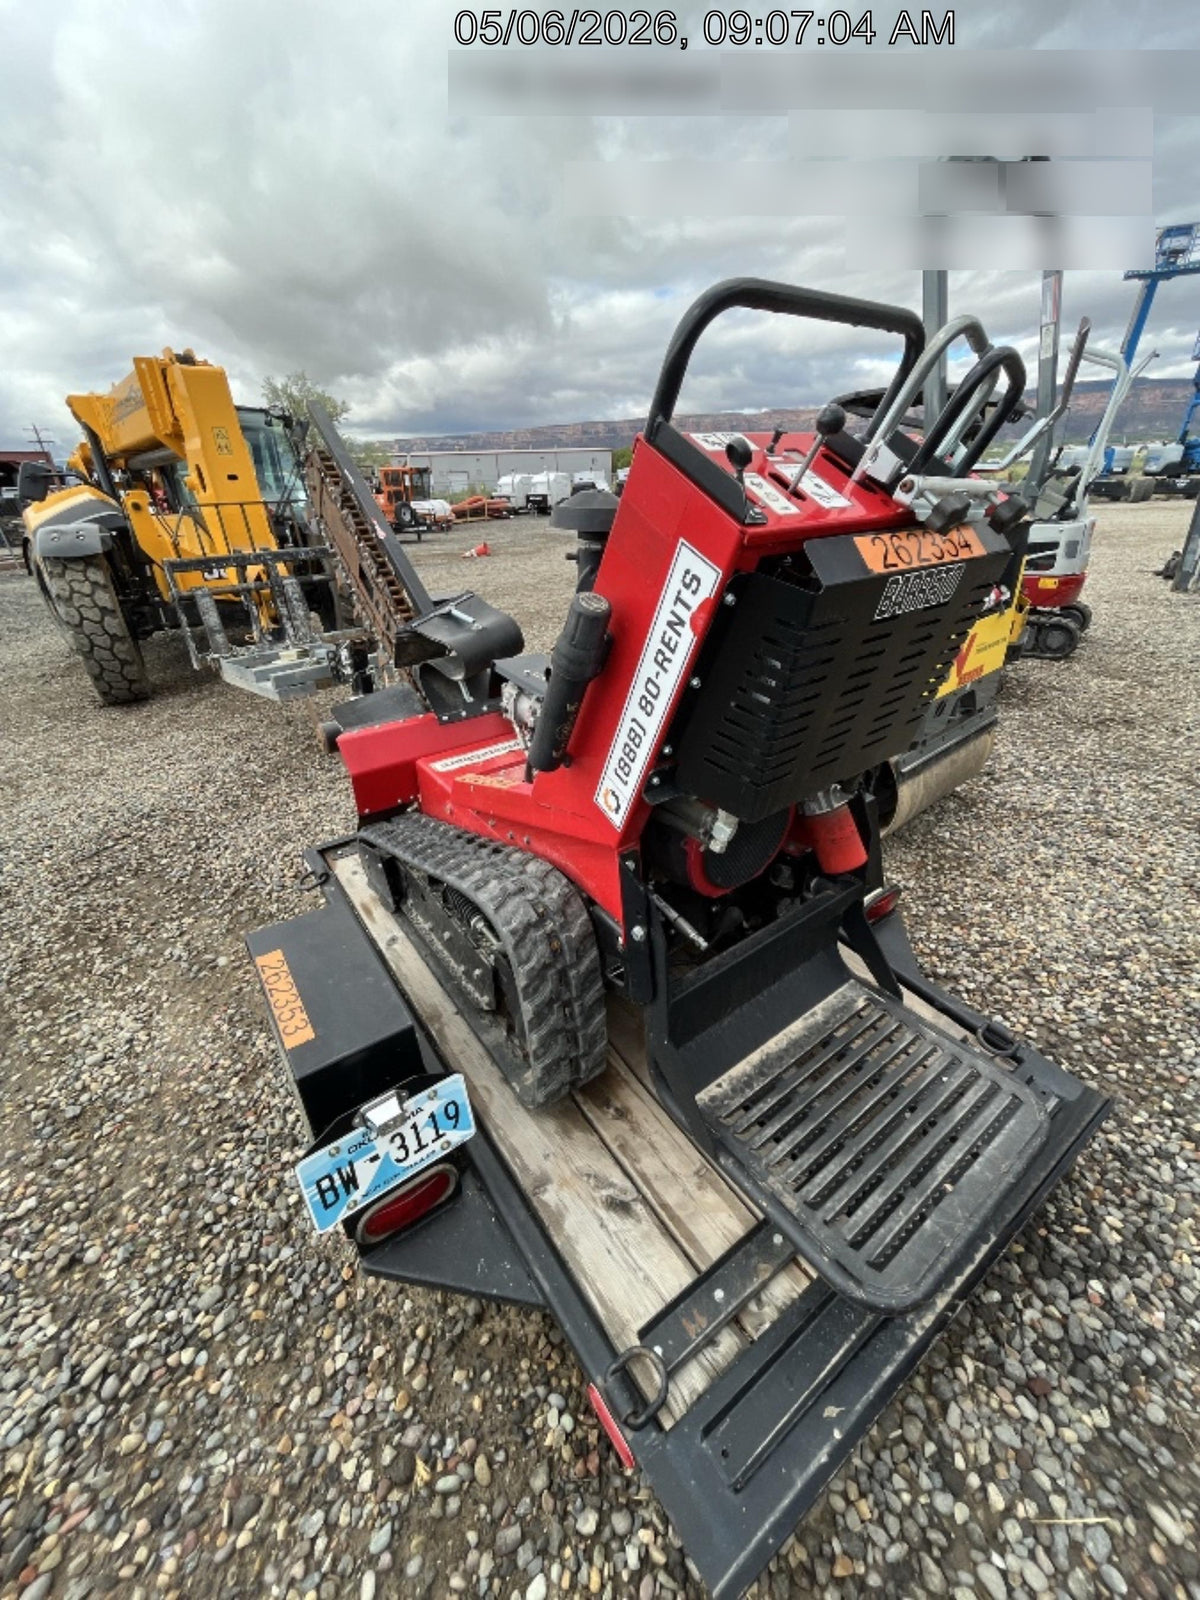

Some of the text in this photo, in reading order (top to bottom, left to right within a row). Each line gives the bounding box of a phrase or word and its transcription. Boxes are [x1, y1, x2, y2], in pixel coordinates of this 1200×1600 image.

[871, 526, 973, 569] 262354
[614, 568, 702, 786] (888) 80-RENTS
[261, 959, 308, 1036] 262353
